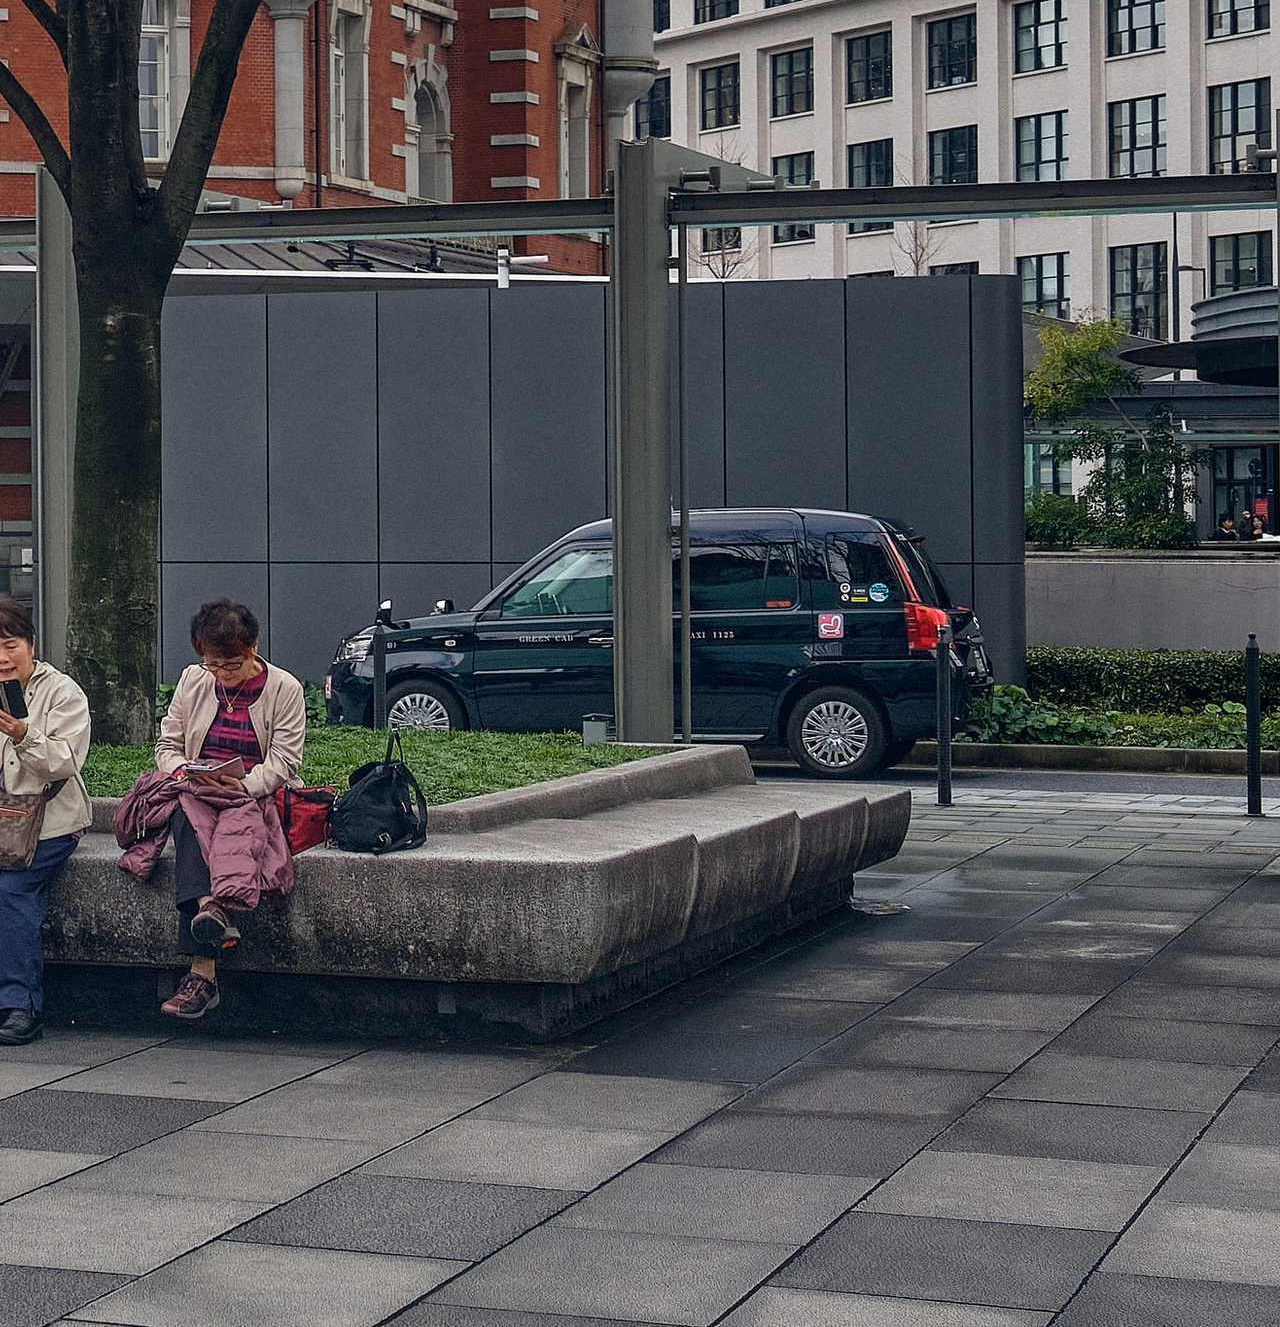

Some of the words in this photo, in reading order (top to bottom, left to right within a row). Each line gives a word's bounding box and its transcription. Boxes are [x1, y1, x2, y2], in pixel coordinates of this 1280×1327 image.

[519, 635, 550, 643] GREEN
[554, 634, 574, 642] CAB
[713, 631, 735, 639] 1125
